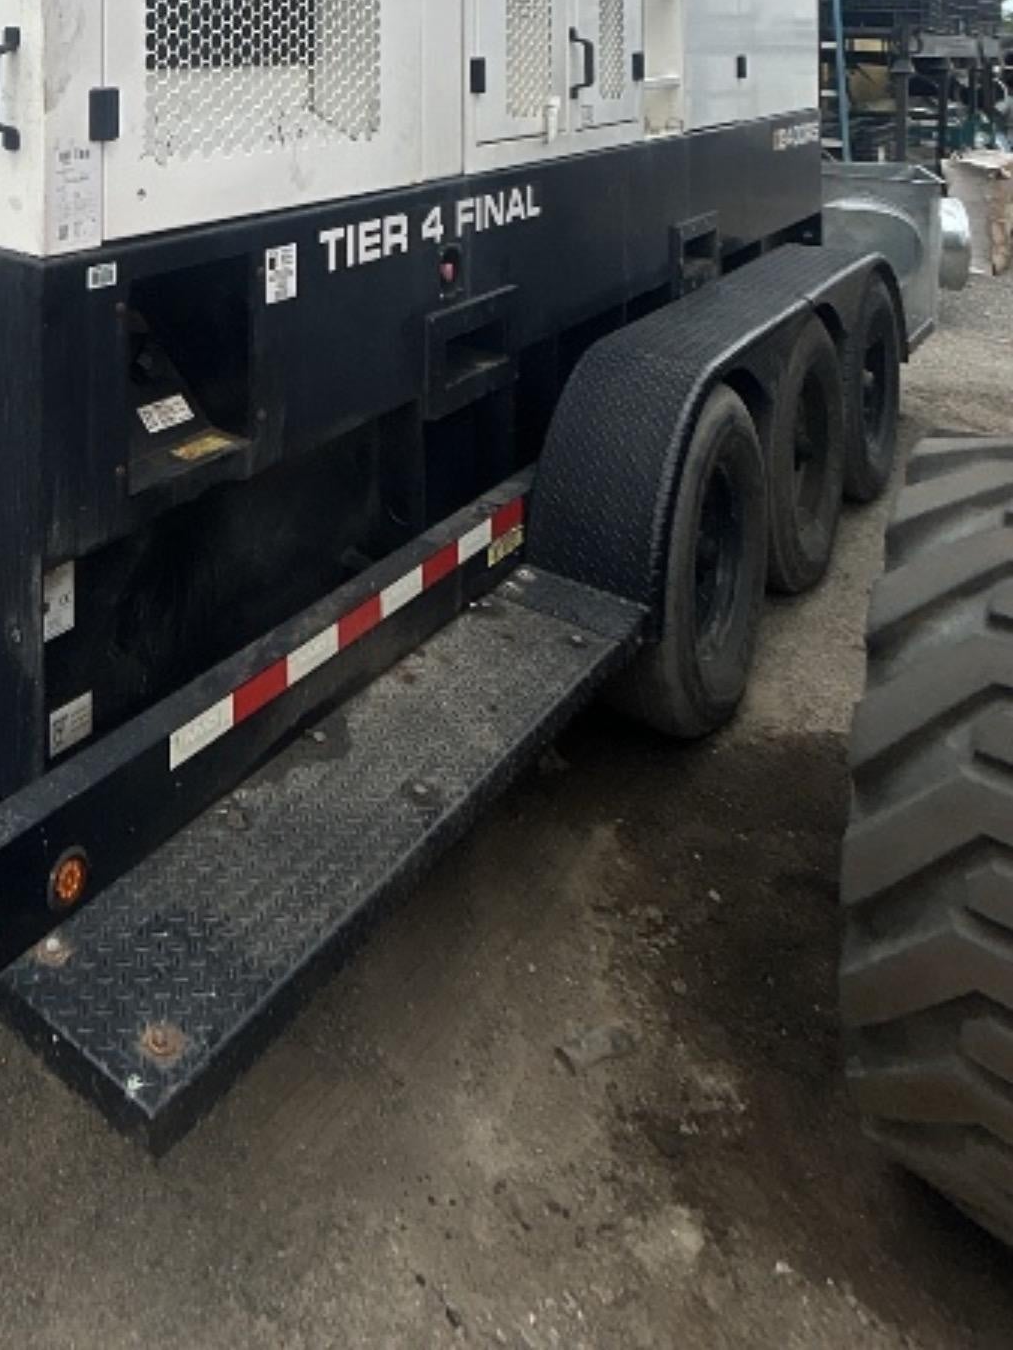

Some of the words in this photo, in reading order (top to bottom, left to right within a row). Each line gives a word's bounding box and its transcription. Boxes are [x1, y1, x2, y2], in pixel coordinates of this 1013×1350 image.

[319, 213, 409, 272] TIER
[421, 206, 444, 243] 4
[455, 184, 542, 237] FINAL
